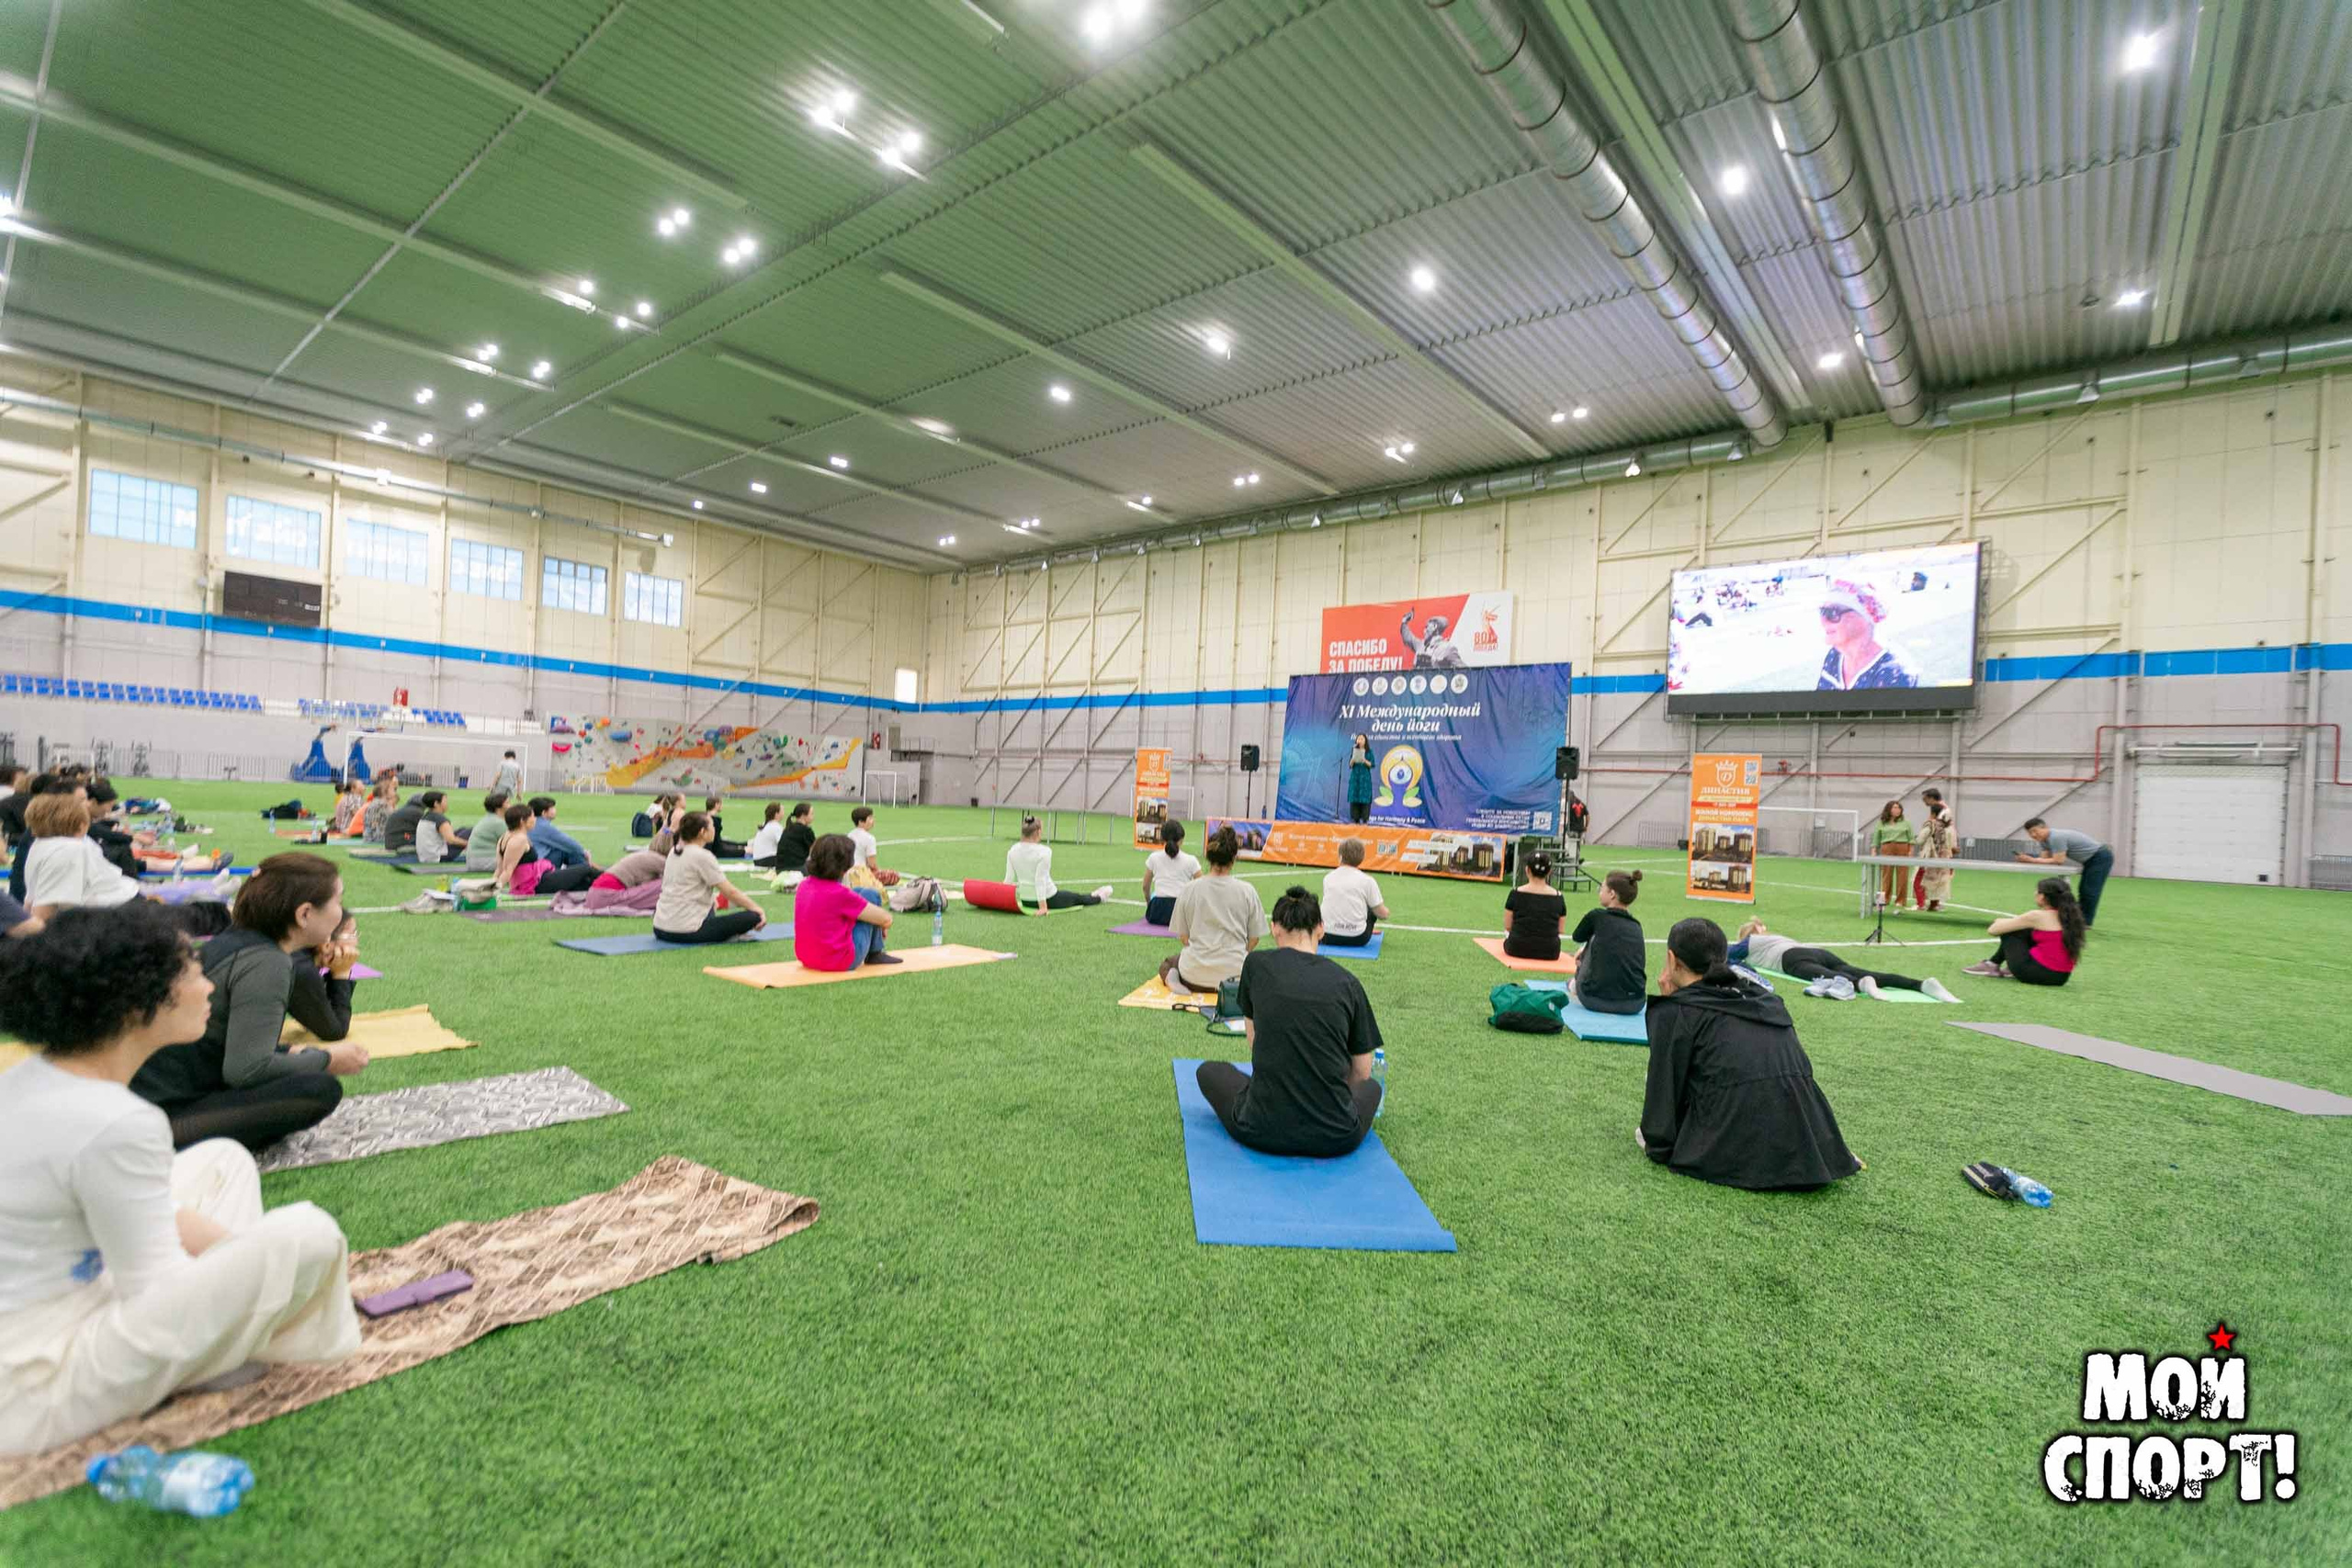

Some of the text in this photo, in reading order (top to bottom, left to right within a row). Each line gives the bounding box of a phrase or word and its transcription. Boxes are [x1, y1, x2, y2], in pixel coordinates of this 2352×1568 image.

[1329, 637, 1387, 658] СПАСИБО
[1329, 660, 1345, 673] ЗА
[1357, 702, 1481, 721] Международный
[1371, 718, 1441, 733] день йоги
